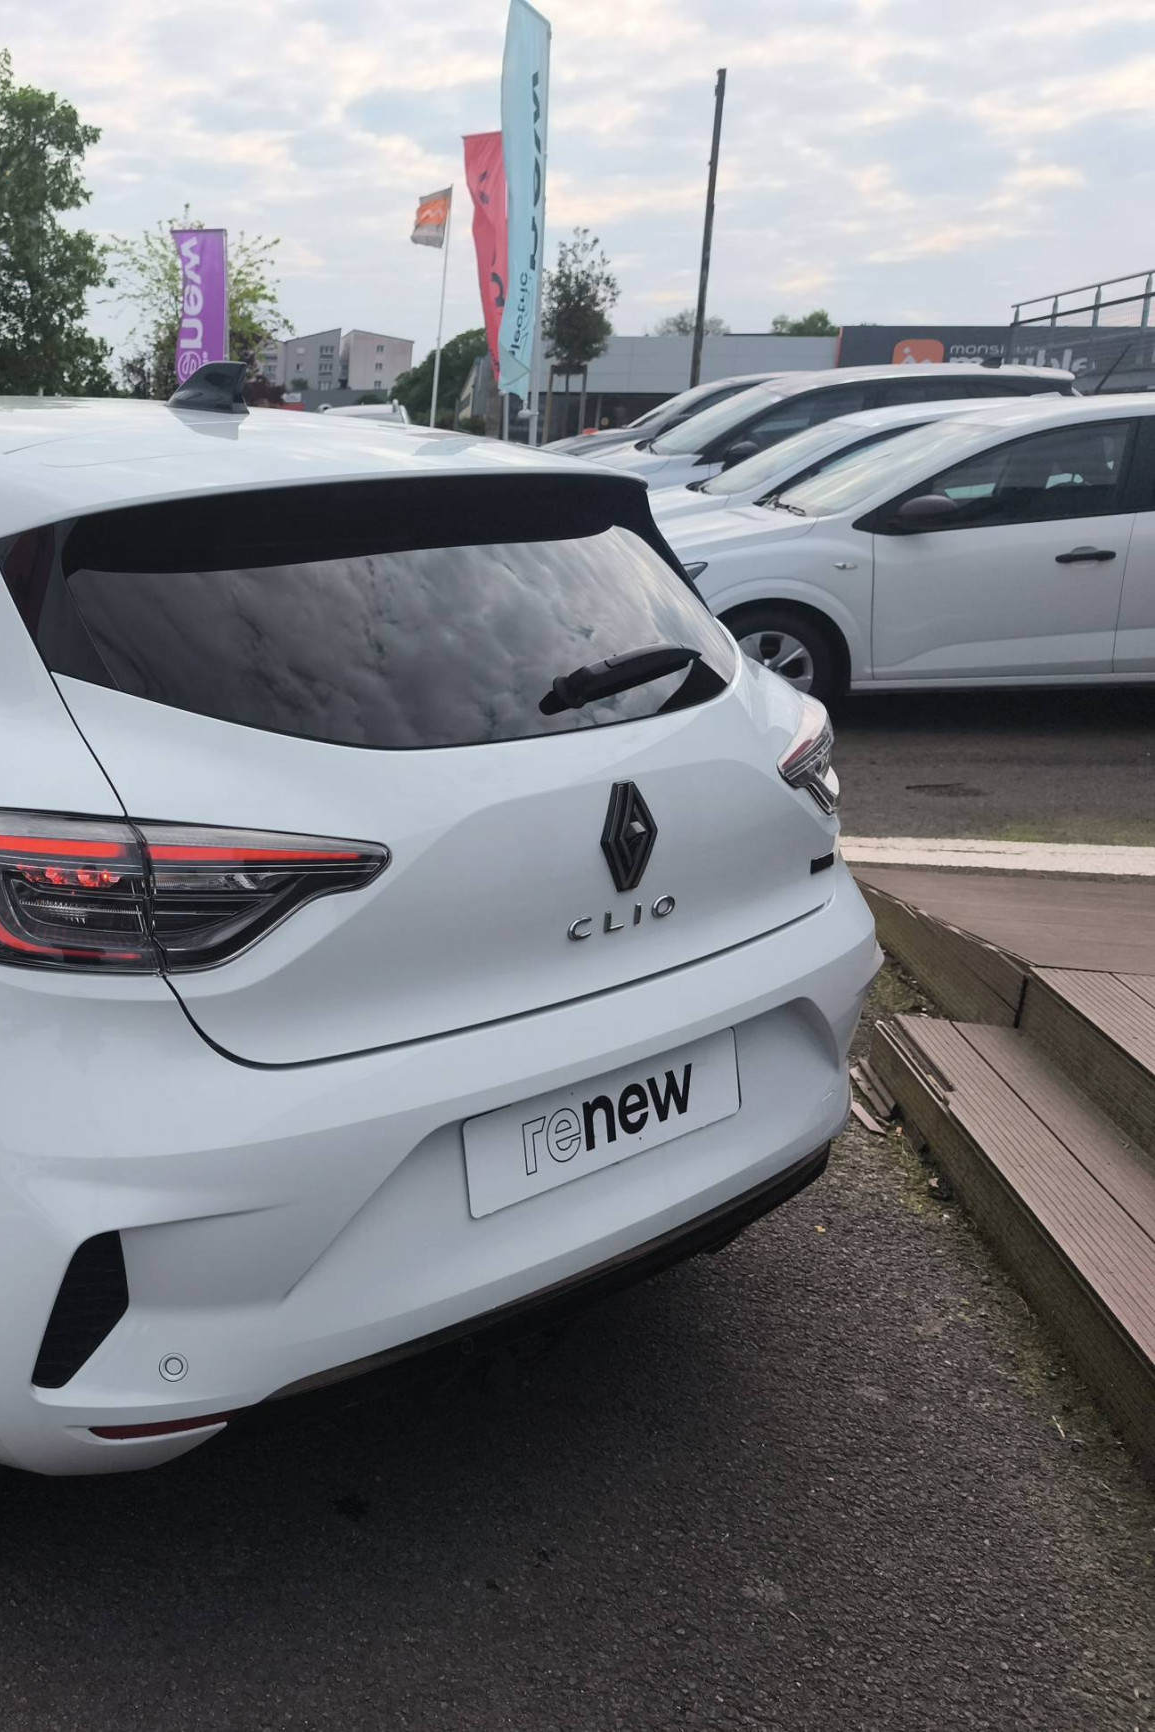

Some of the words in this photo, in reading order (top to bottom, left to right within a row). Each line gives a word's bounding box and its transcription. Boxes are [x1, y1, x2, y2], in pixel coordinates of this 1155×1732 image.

[949, 344, 1038, 355] monsiur
[567, 894, 676, 942] CLIO
[521, 1062, 693, 1176] renew
